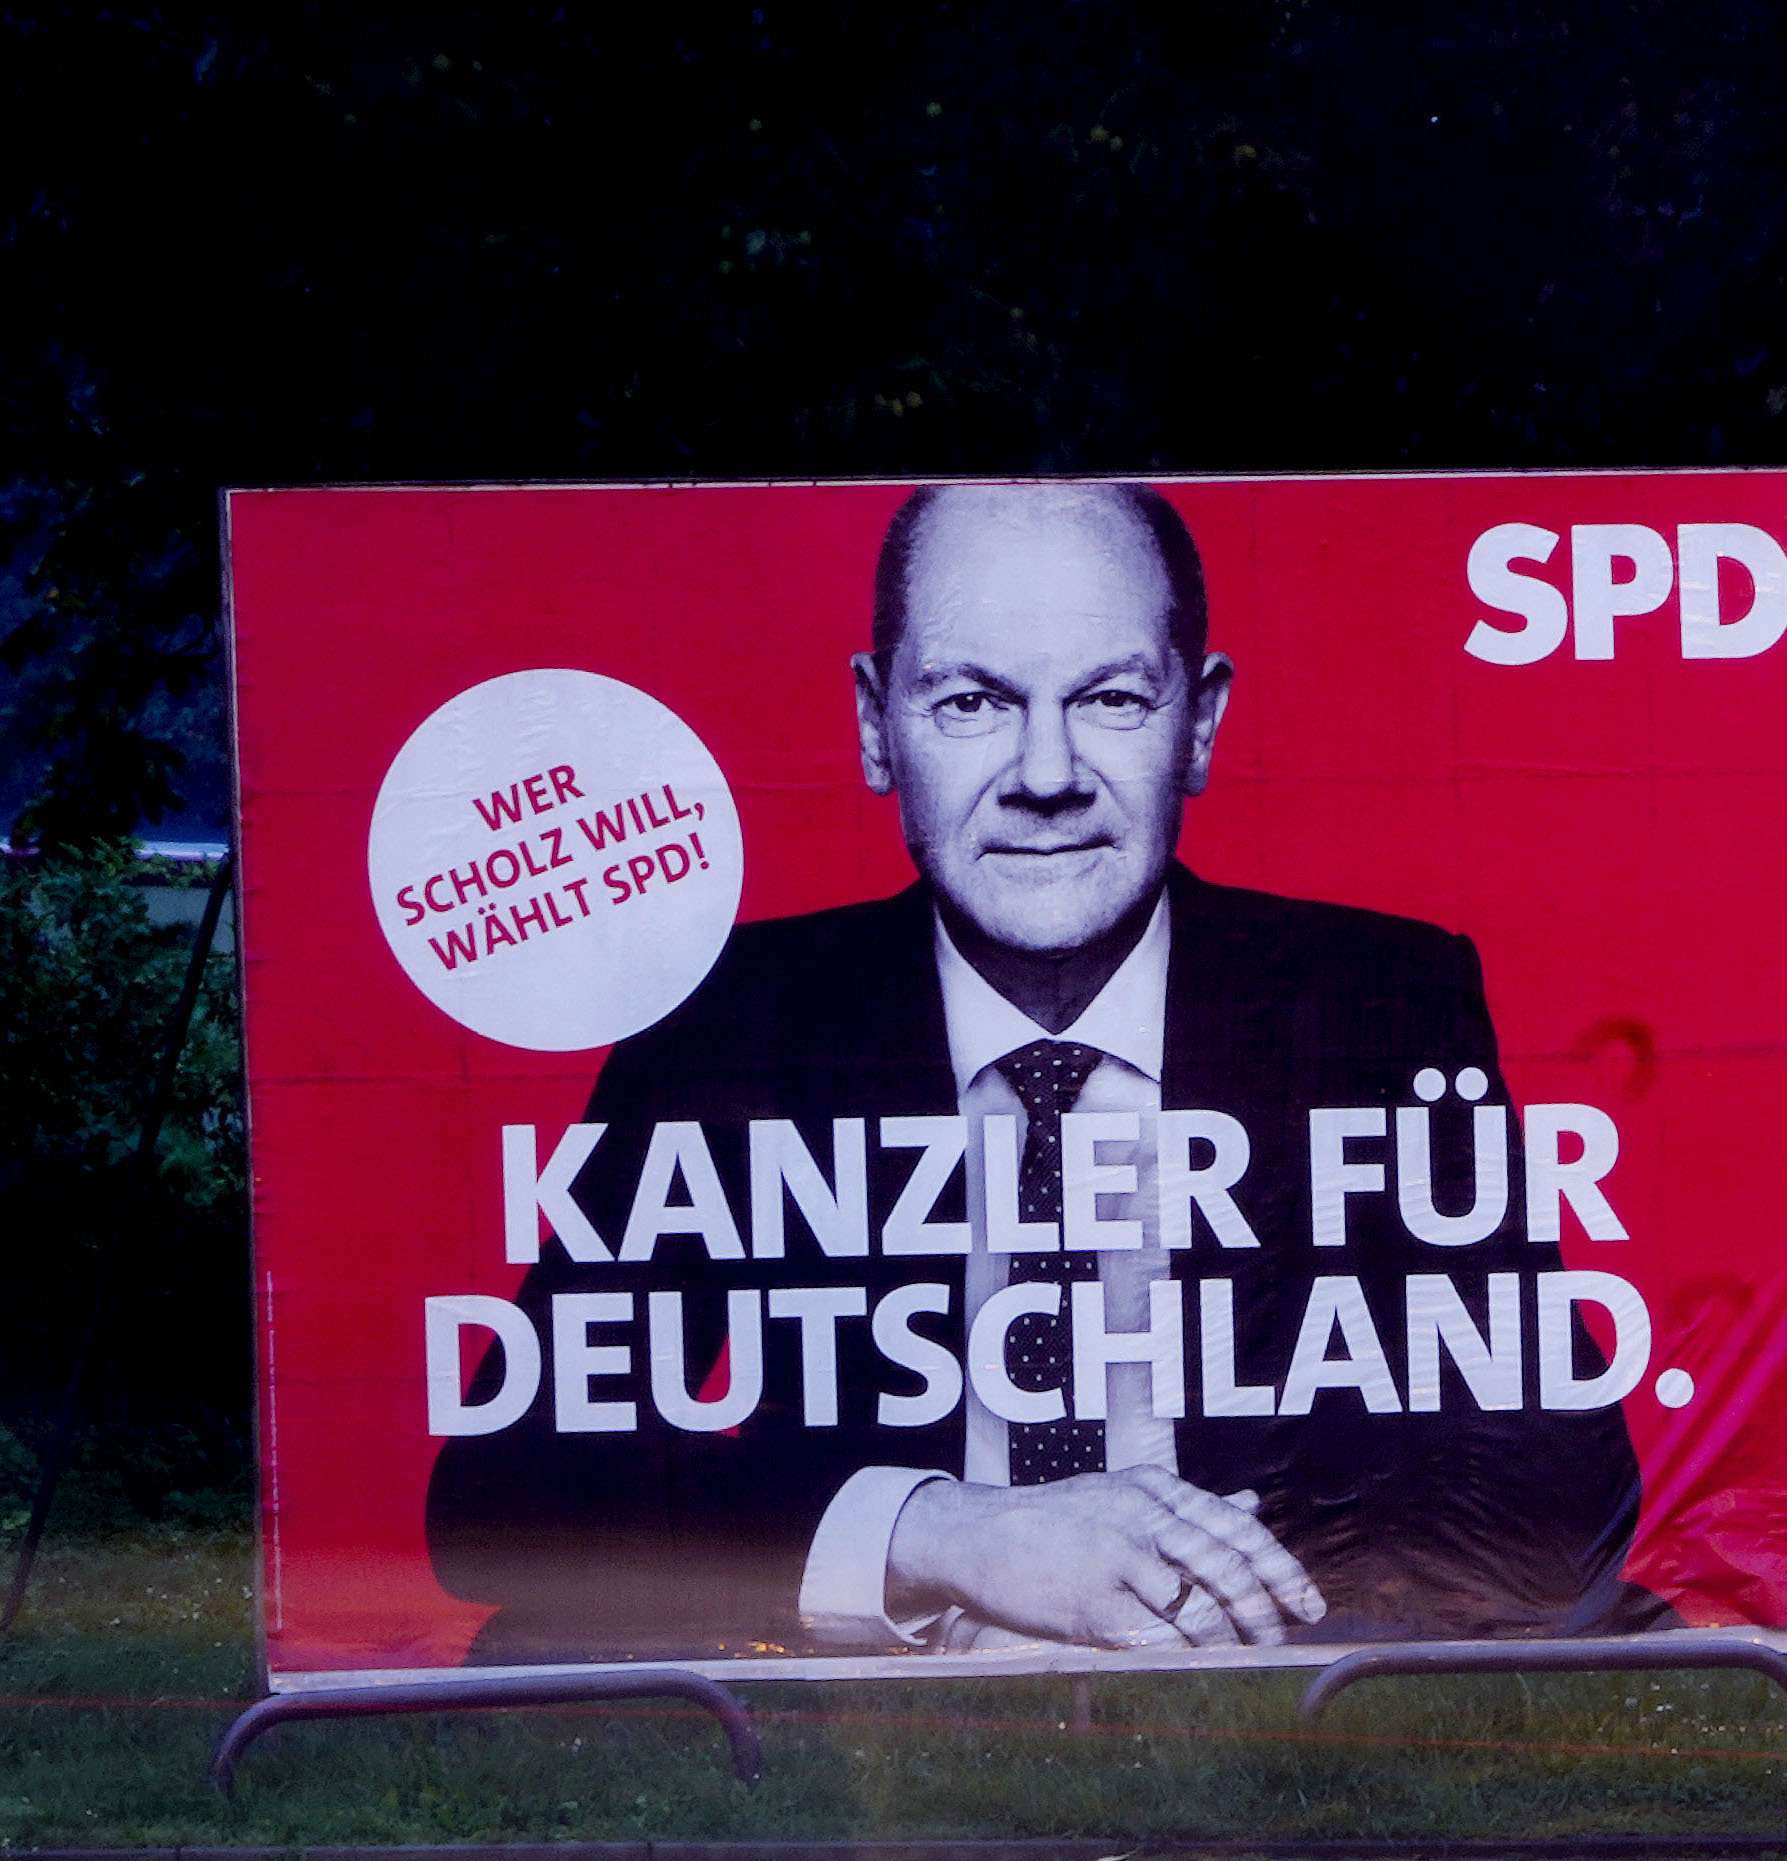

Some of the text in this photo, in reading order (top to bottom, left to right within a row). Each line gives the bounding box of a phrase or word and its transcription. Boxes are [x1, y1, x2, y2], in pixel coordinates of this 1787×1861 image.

[396, 784, 706, 926] SCHOLZ WILL,
[472, 764, 585, 832] WER
[427, 831, 709, 971] WÄHLT SPD!
[503, 1067, 1629, 1265] KANZLER FÜR
[423, 1268, 1697, 1438] DEUTSCHLAND.
